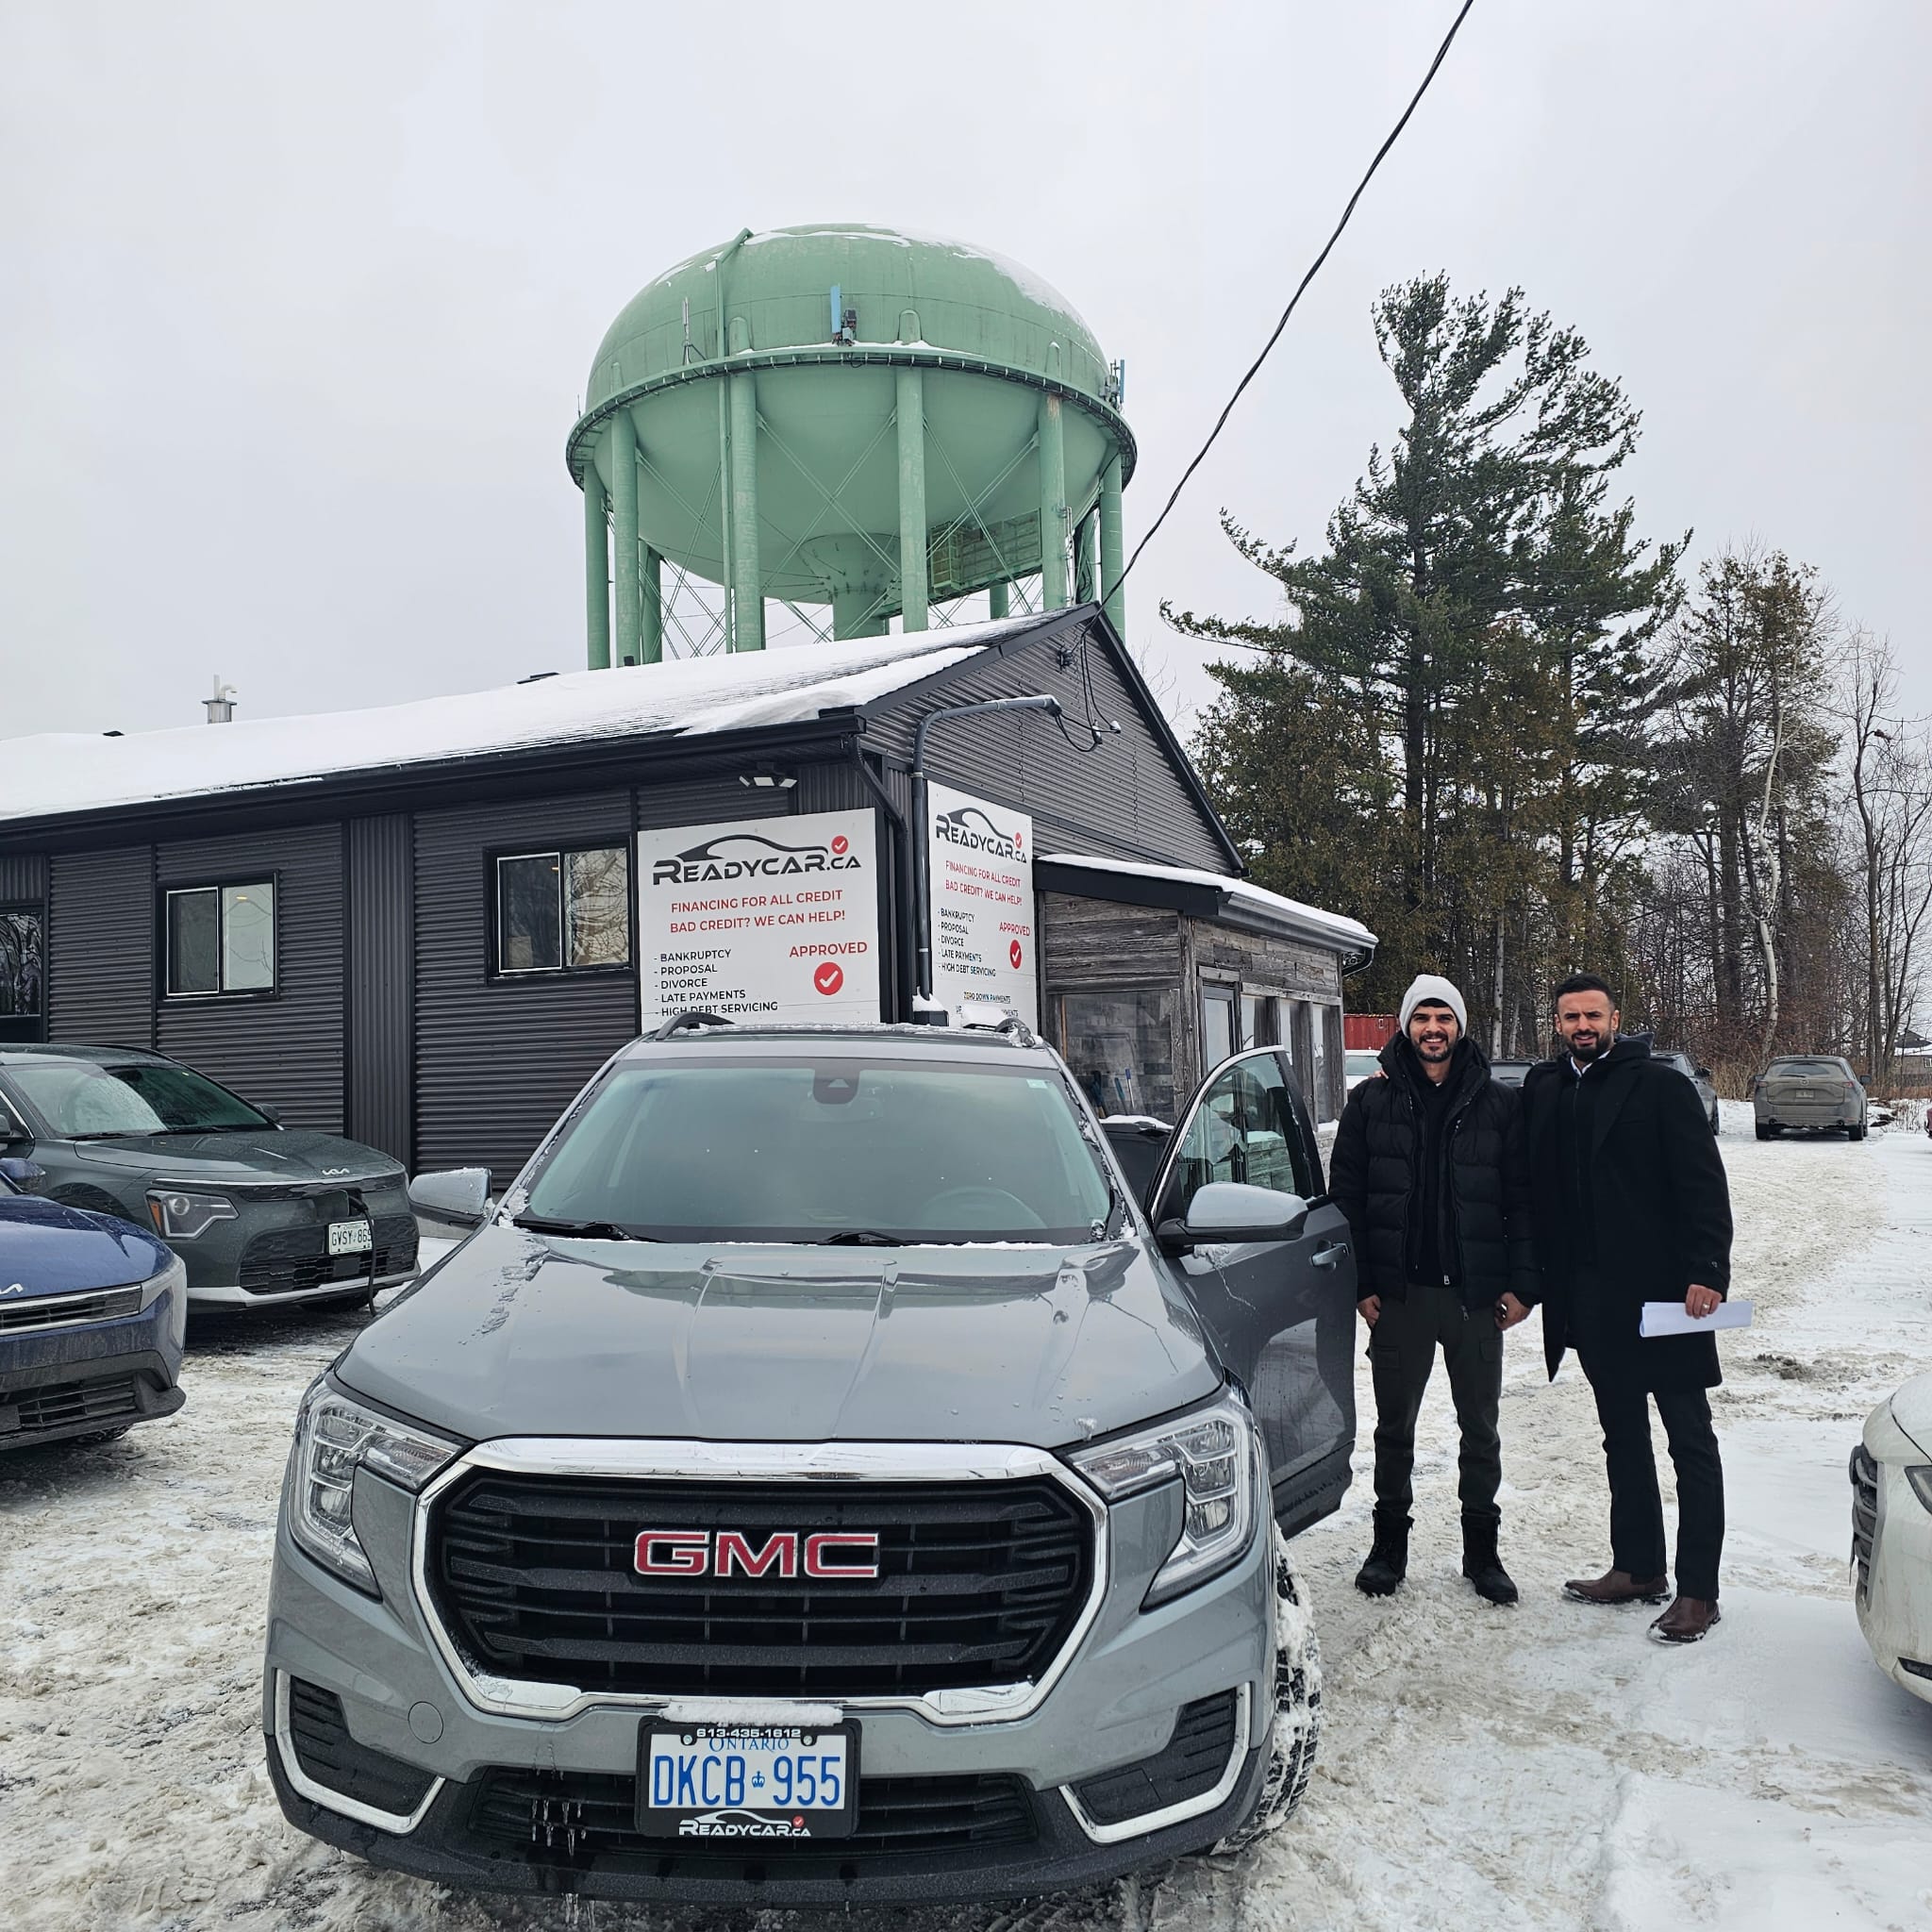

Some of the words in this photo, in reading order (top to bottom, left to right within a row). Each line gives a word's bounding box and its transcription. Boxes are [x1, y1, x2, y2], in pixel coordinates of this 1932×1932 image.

[945, 860, 977, 878] FINANCING
[978, 868, 991, 881] FOR
[991, 871, 1002, 884] ALL
[1002, 874, 1021, 888] CREDIT
[945, 879, 958, 892] BAD
[959, 883, 983, 897] CREDIT?
[984, 889, 994, 901] WE
[994, 891, 1007, 903] CAN
[1007, 892, 1023, 906] HELP!
[671, 897, 739, 913] FINANCING
[741, 895, 767, 908] FOR
[770, 894, 793, 906] ALL
[796, 890, 843, 904] CREDIT
[670, 921, 696, 933] BAD
[699, 917, 751, 931] CREDIT?
[754, 915, 775, 927] WE
[778, 913, 805, 925] CAN
[808, 910, 845, 923] HELP!
[941, 908, 975, 923] BANKRUPTCY
[941, 922, 969, 934] PROPOSAL
[999, 922, 1031, 936] APPROVED
[941, 935, 964, 946] DIVORCE
[660, 949, 732, 962] BANKRUPTCY
[789, 941, 868, 958] APPROVED
[941, 948, 954, 958] LATE
[955, 951, 982, 962] PAYMENTS
[660, 964, 718, 975] PROPOSAL
[956, 964, 969, 974] DEBT
[970, 965, 996, 977] SERVICING
[660, 977, 708, 990] DIVORCE
[661, 992, 687, 1003] LATE
[689, 990, 746, 1002] PAYMENTS
[661, 1006, 688, 1017] HIGH
[721, 1001, 778, 1013] SERVICING
[331, 1229, 353, 1246] GVSY
[634, 1530, 879, 1577] GMC
[696, 1727, 801, 1739] 613-435-1612
[654, 1755, 745, 1807] DKCB
[773, 1756, 841, 1807] 955
